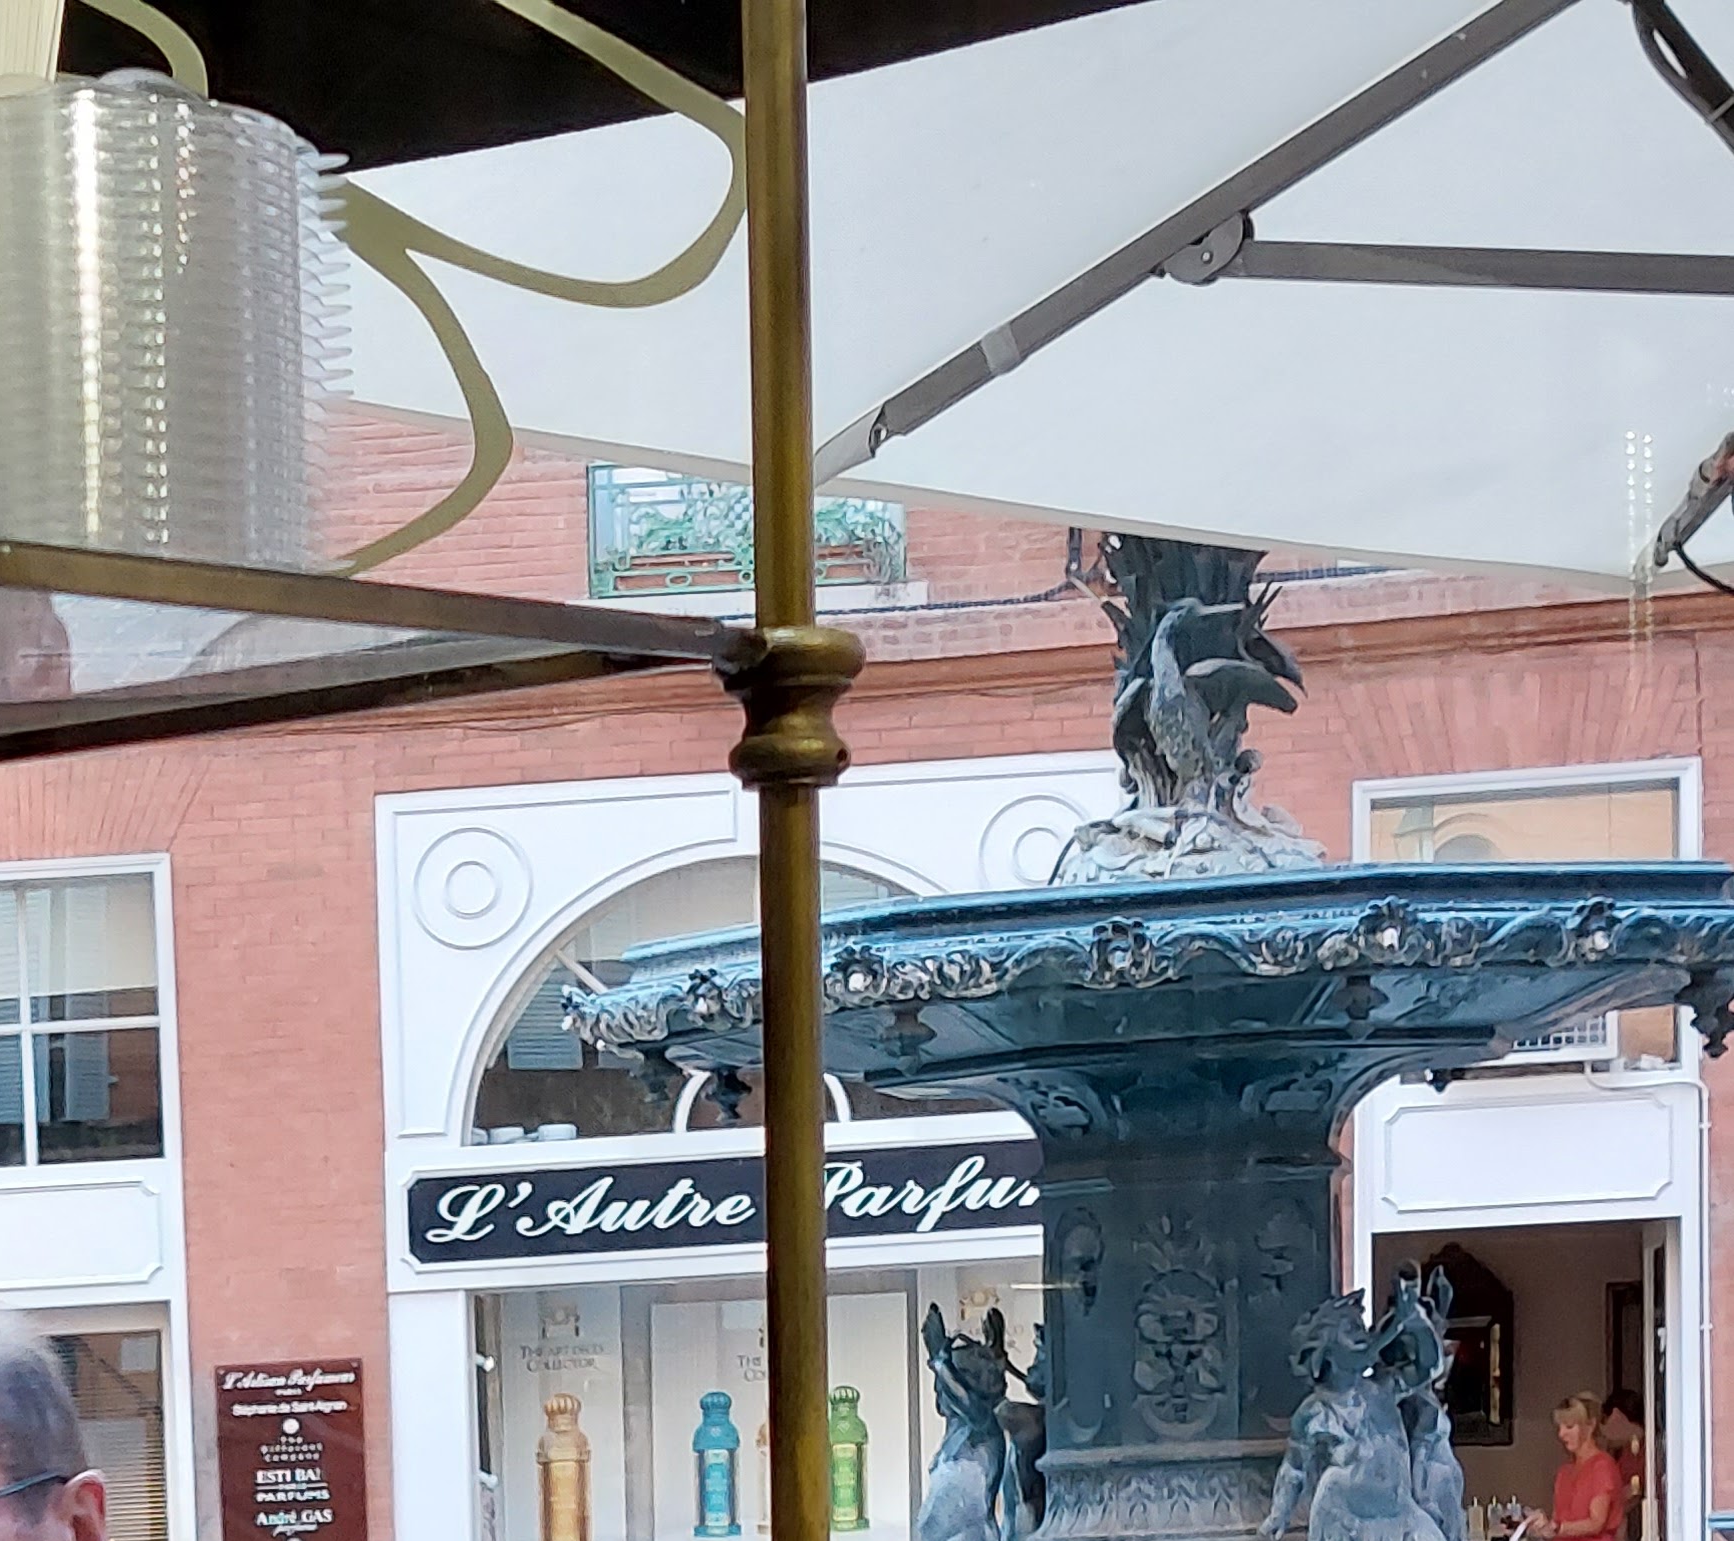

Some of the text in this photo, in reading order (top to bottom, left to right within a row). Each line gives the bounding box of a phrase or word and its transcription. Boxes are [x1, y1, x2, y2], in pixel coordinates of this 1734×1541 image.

[424, 1154, 1041, 1243] L'Autre Parfu
[300, 1508, 334, 1523] GAS
